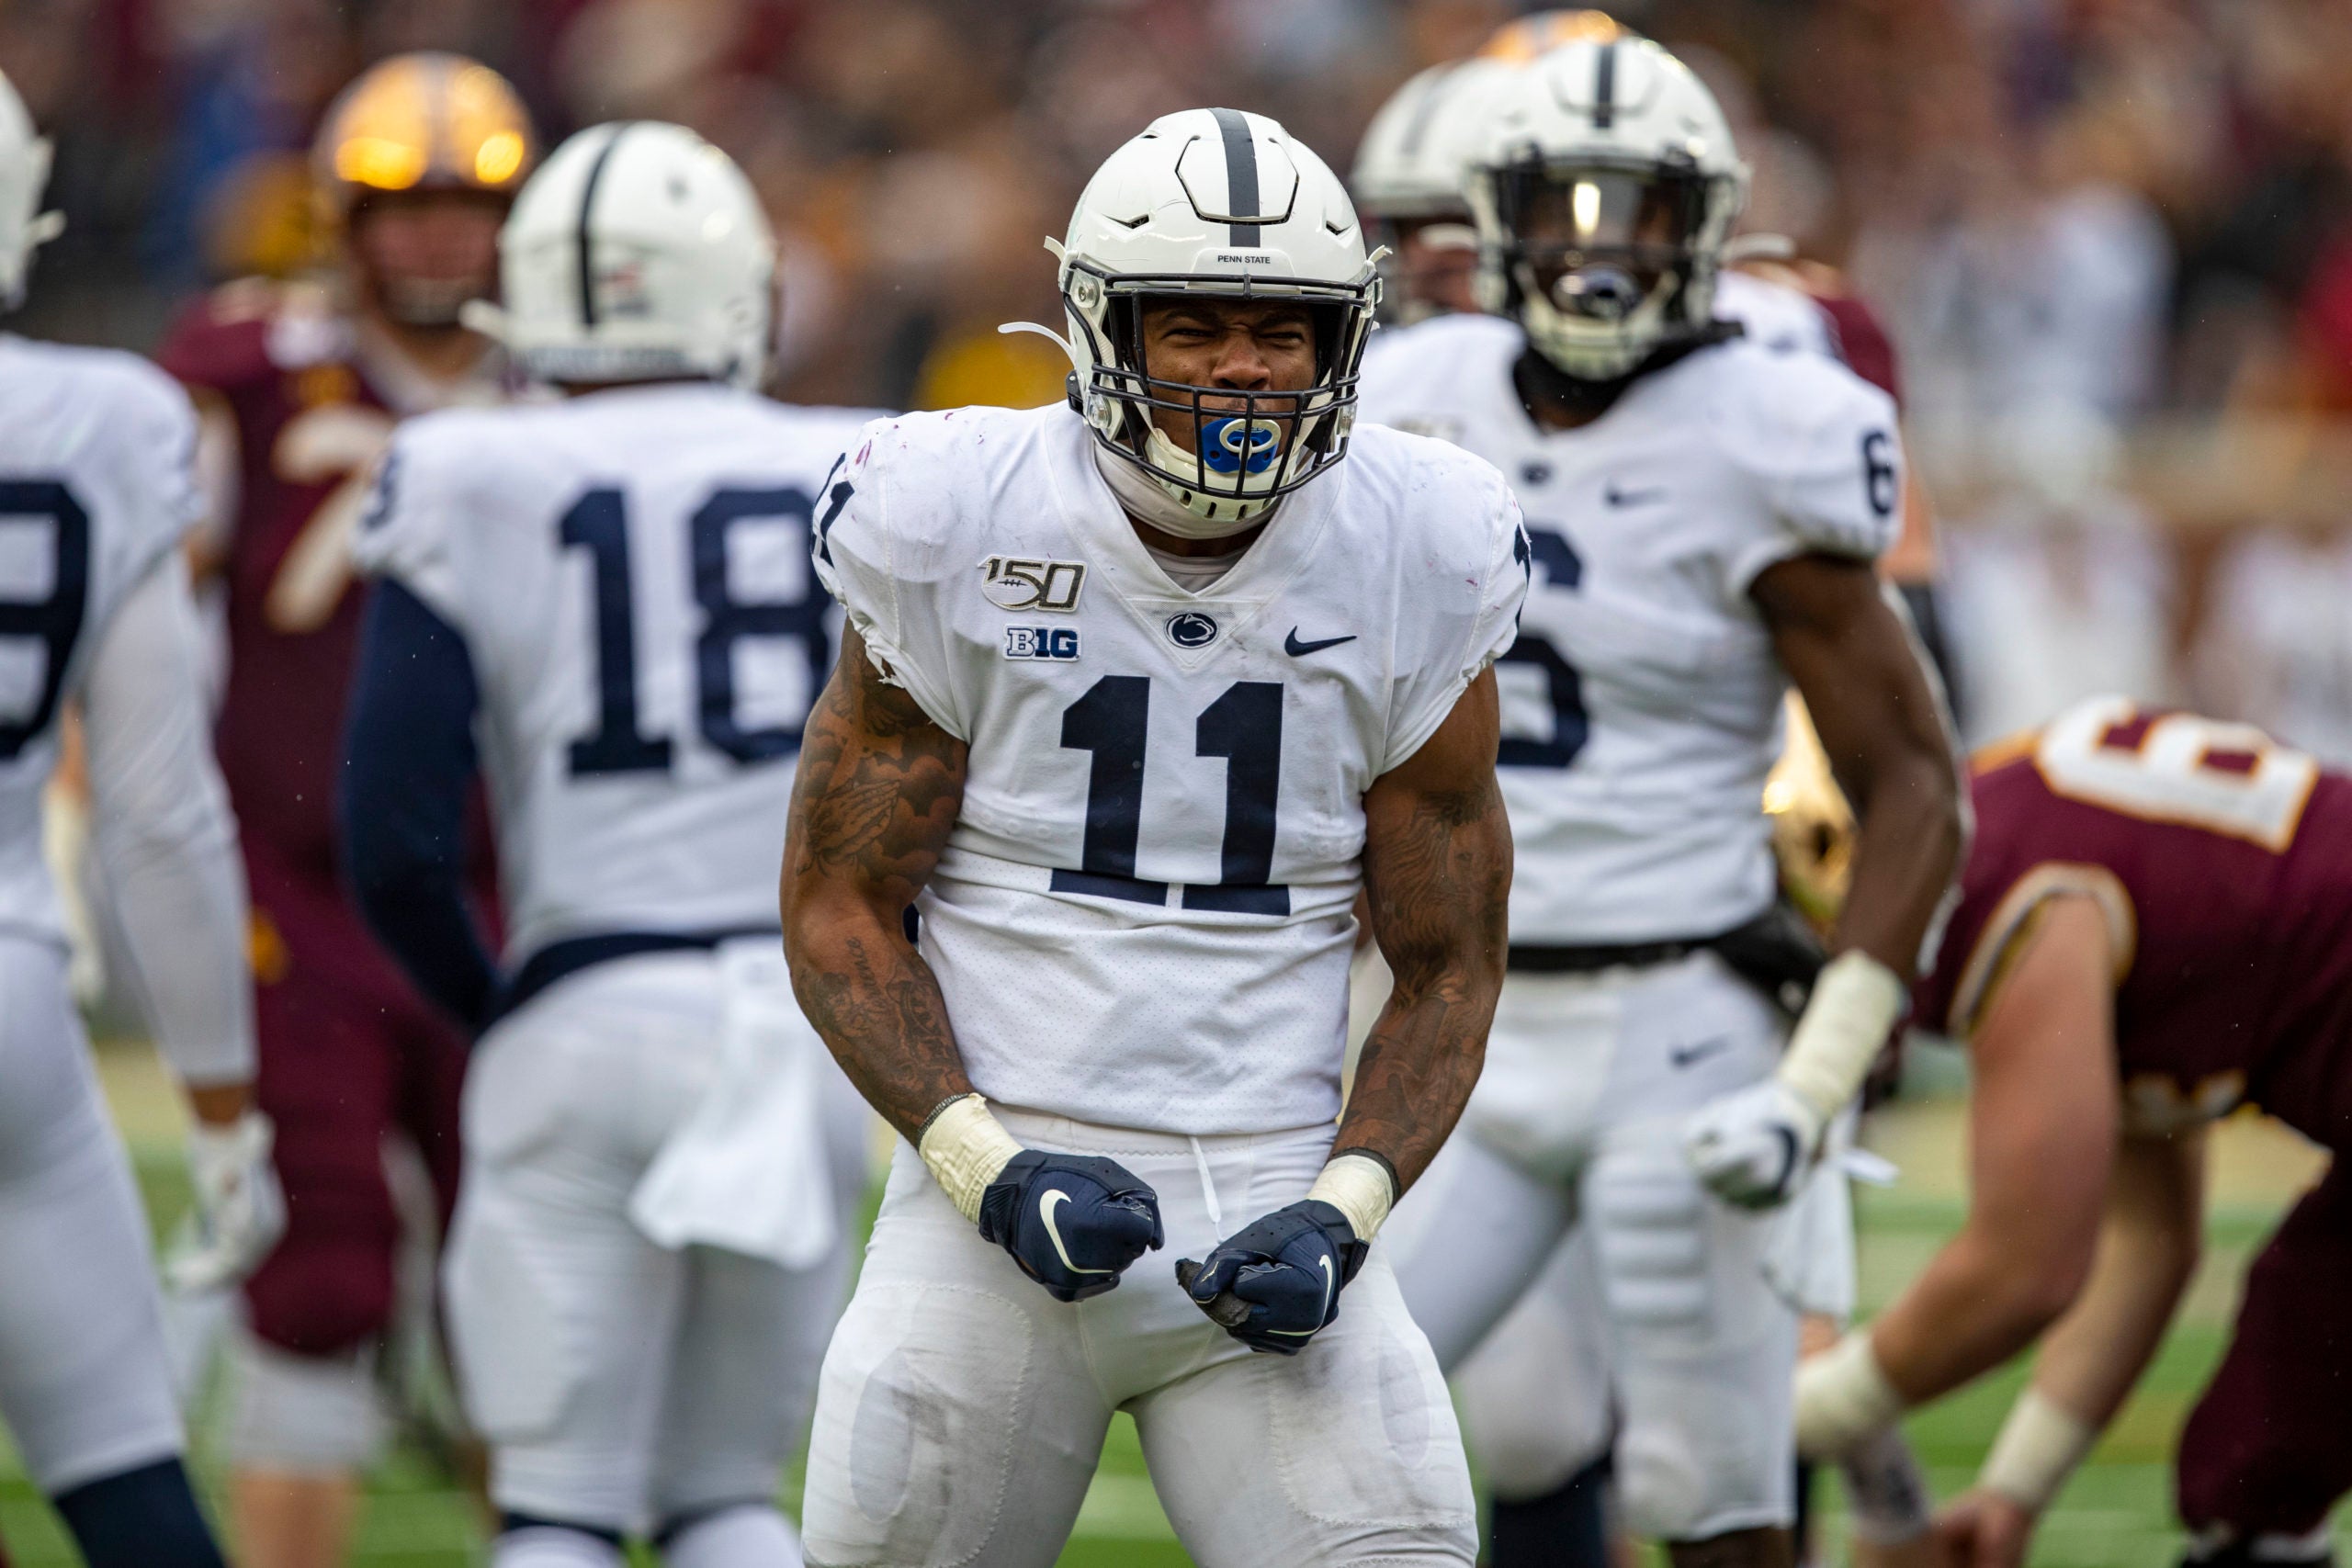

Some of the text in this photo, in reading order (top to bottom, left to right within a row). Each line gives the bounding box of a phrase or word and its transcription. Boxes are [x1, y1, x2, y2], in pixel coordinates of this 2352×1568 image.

[1217, 254, 1271, 265] PENN STATE
[1862, 429, 1895, 517] 6
[980, 557, 1085, 609] 150
[560, 489, 831, 775] 18
[1049, 674, 1291, 917] 11
